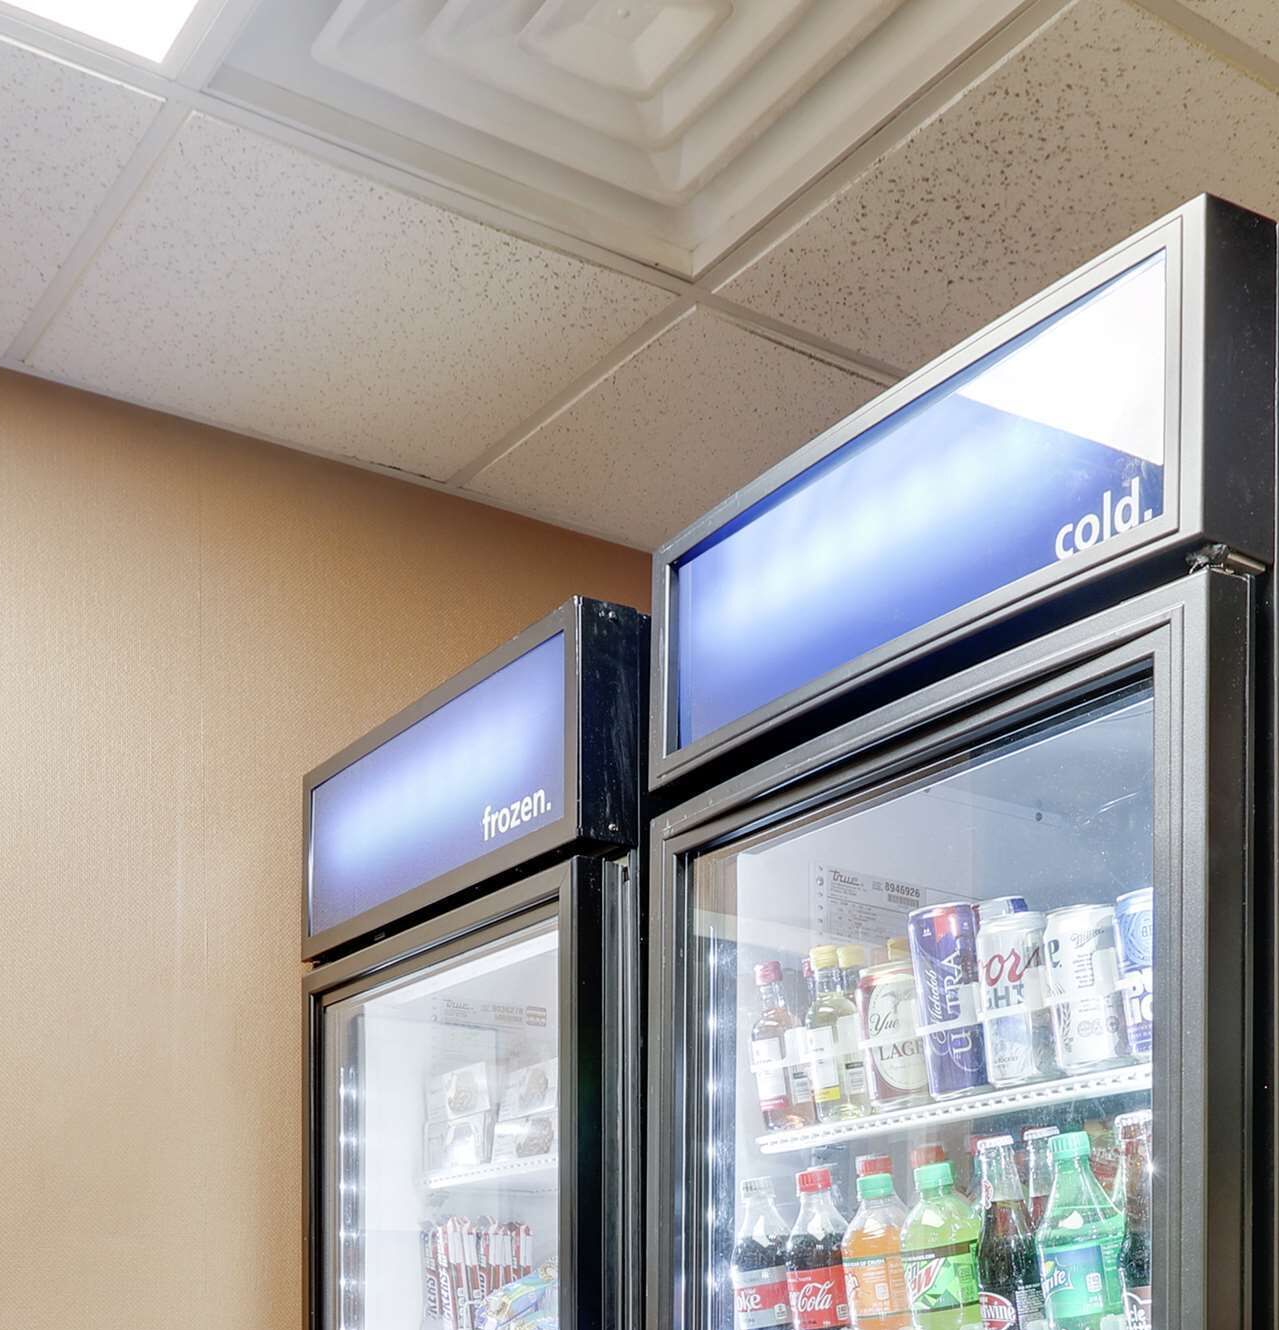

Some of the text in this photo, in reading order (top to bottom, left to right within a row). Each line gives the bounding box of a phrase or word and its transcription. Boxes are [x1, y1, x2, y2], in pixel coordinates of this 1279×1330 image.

[1055, 476, 1153, 560] cold.
[482, 789, 552, 841] frozen.
[797, 1280, 835, 1313] Cola
